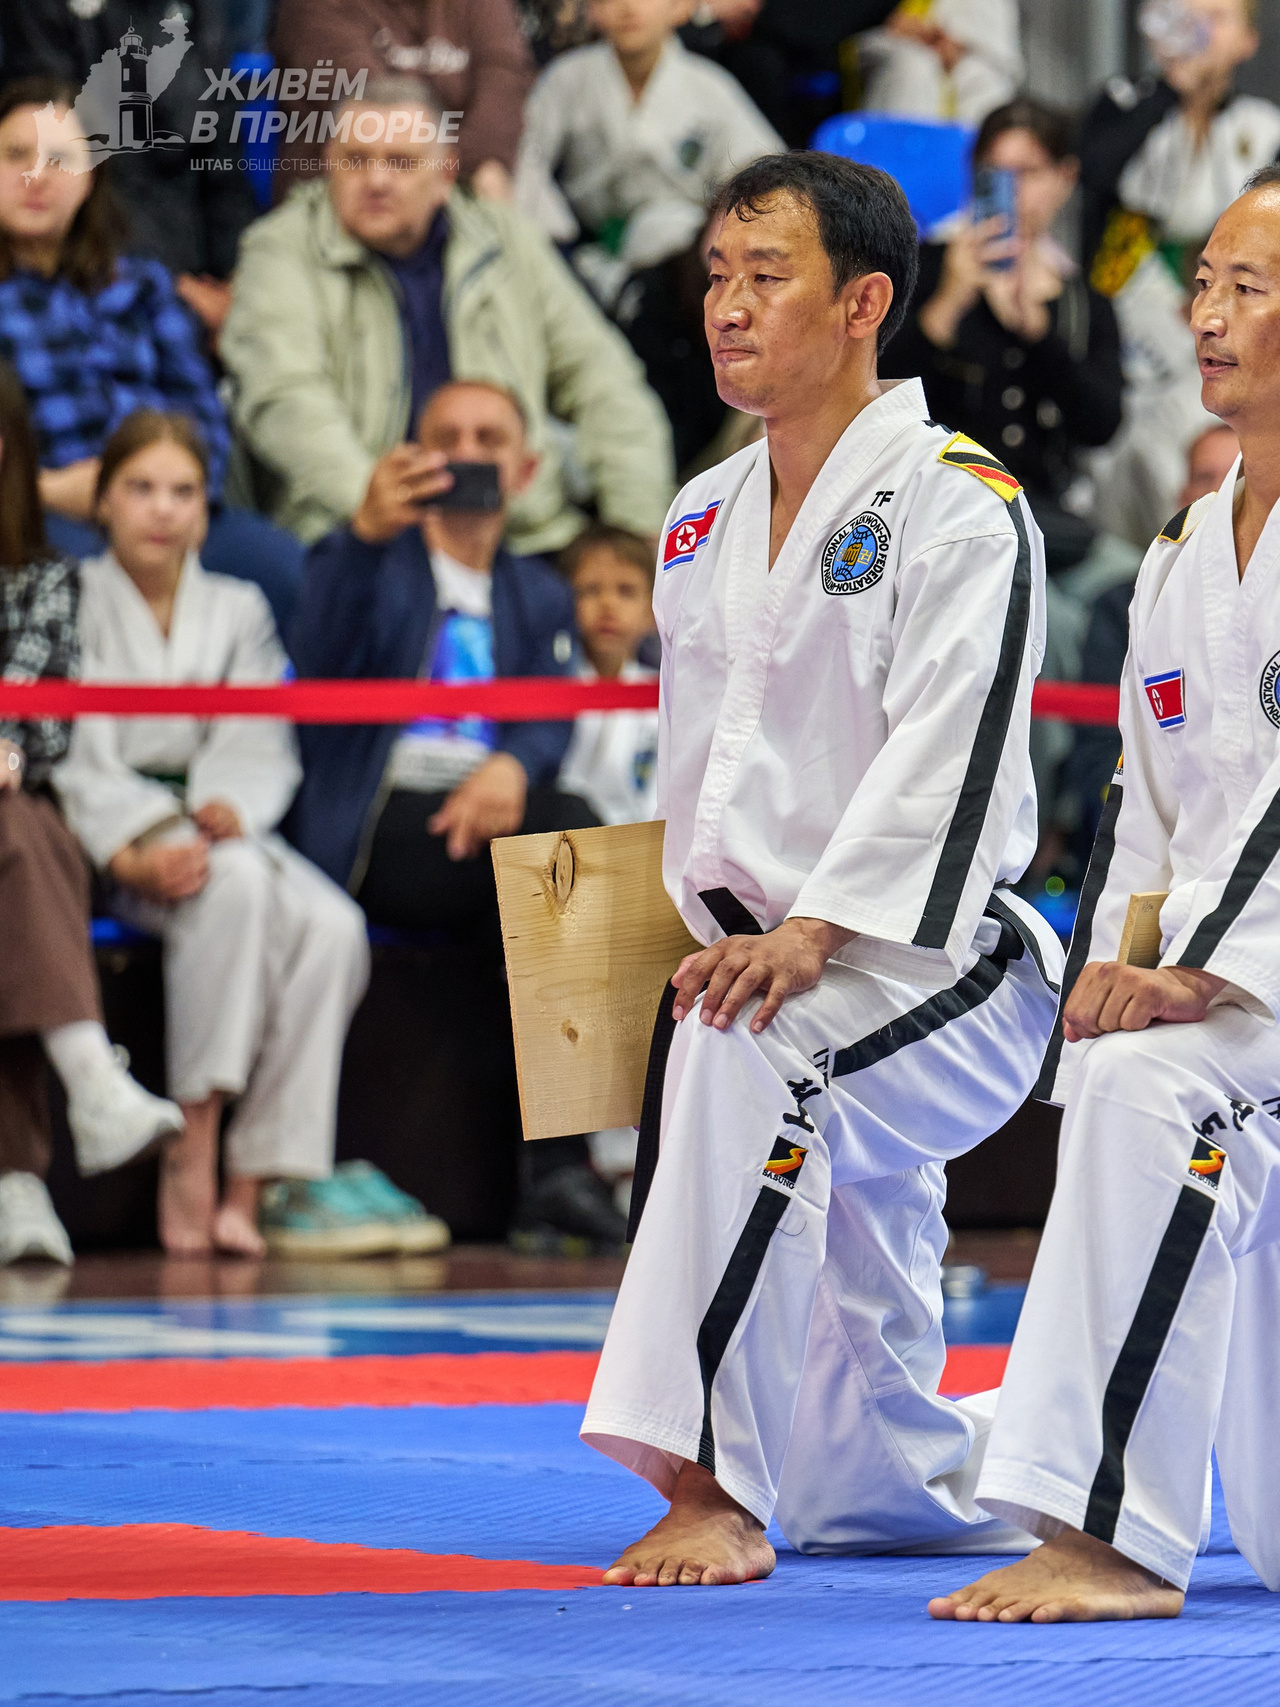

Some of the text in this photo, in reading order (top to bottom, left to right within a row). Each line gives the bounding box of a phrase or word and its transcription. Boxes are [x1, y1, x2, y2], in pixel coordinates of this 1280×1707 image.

[870, 491, 895, 507] TF
[850, 515, 889, 552] TAEKWON-DO
[762, 1169, 796, 1190] SASUNG
